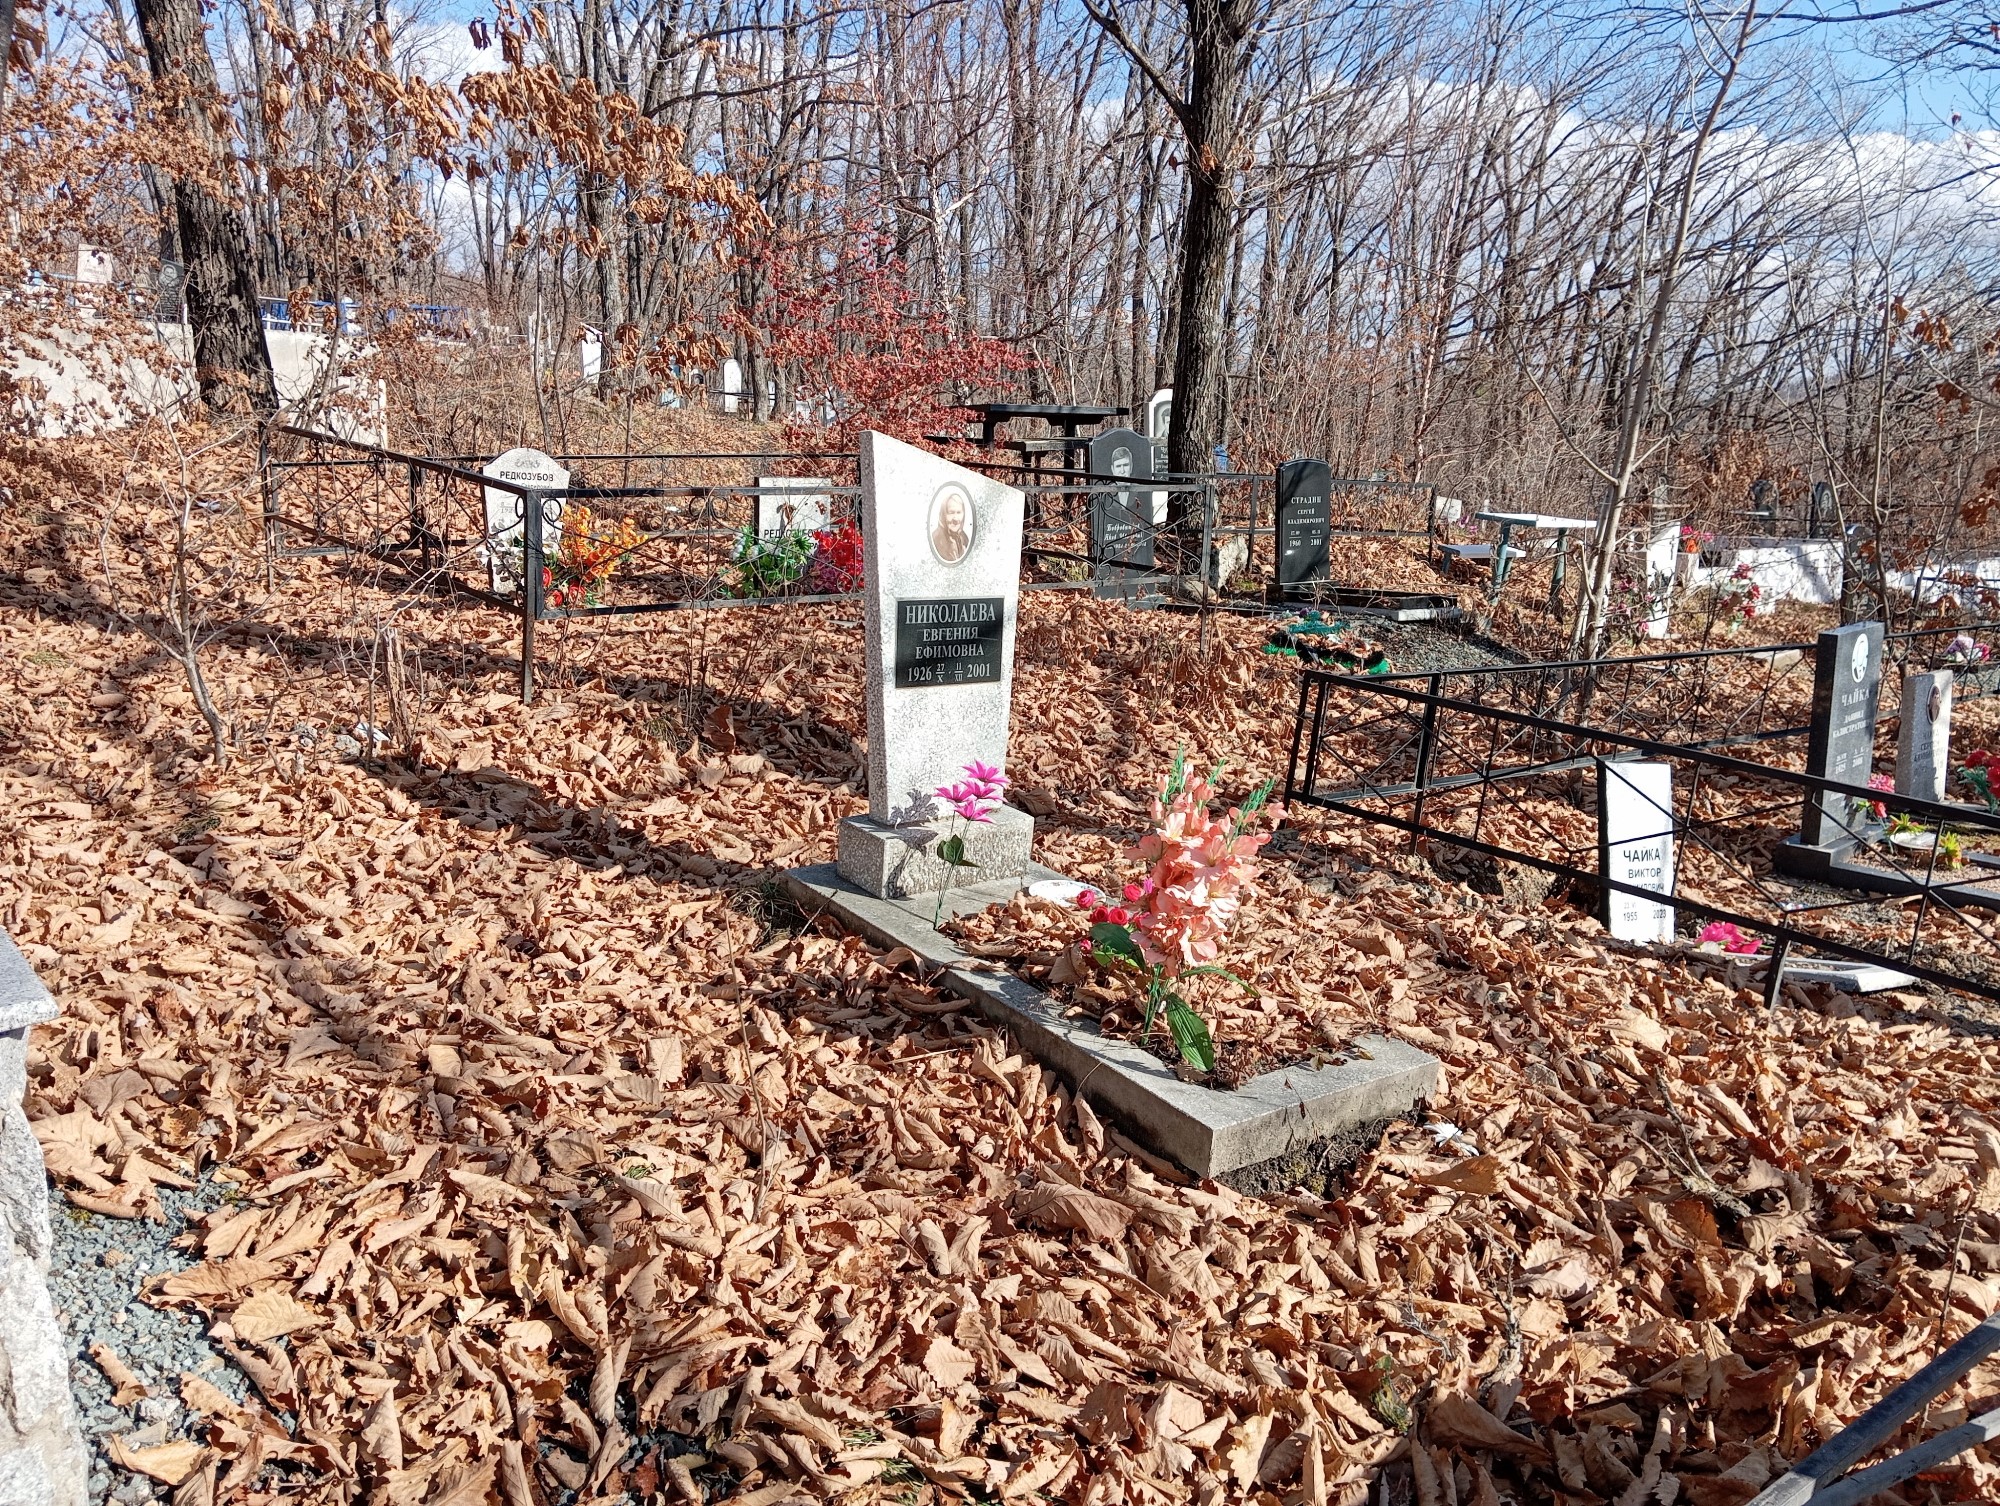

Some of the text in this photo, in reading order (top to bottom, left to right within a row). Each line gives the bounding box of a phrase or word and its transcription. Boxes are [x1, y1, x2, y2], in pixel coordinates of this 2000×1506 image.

[499, 470, 554, 482] РЕДКОЗУБОВ
[905, 603, 996, 625] НИКОЛАЕВА
[923, 626, 979, 642] ЕВГЕНИЯ
[915, 643, 985, 660] ЕФИМОВНА
[908, 666, 933, 682] 1926
[936, 663, 945, 672] 27
[967, 663, 991, 678] 2001
[1841, 687, 1870, 707] ЧАЙКА
[1623, 846, 1661, 862] ЧАЙКА
[1628, 867, 1662, 879] ВИКТОР
[1623, 911, 1638, 922] 1955
